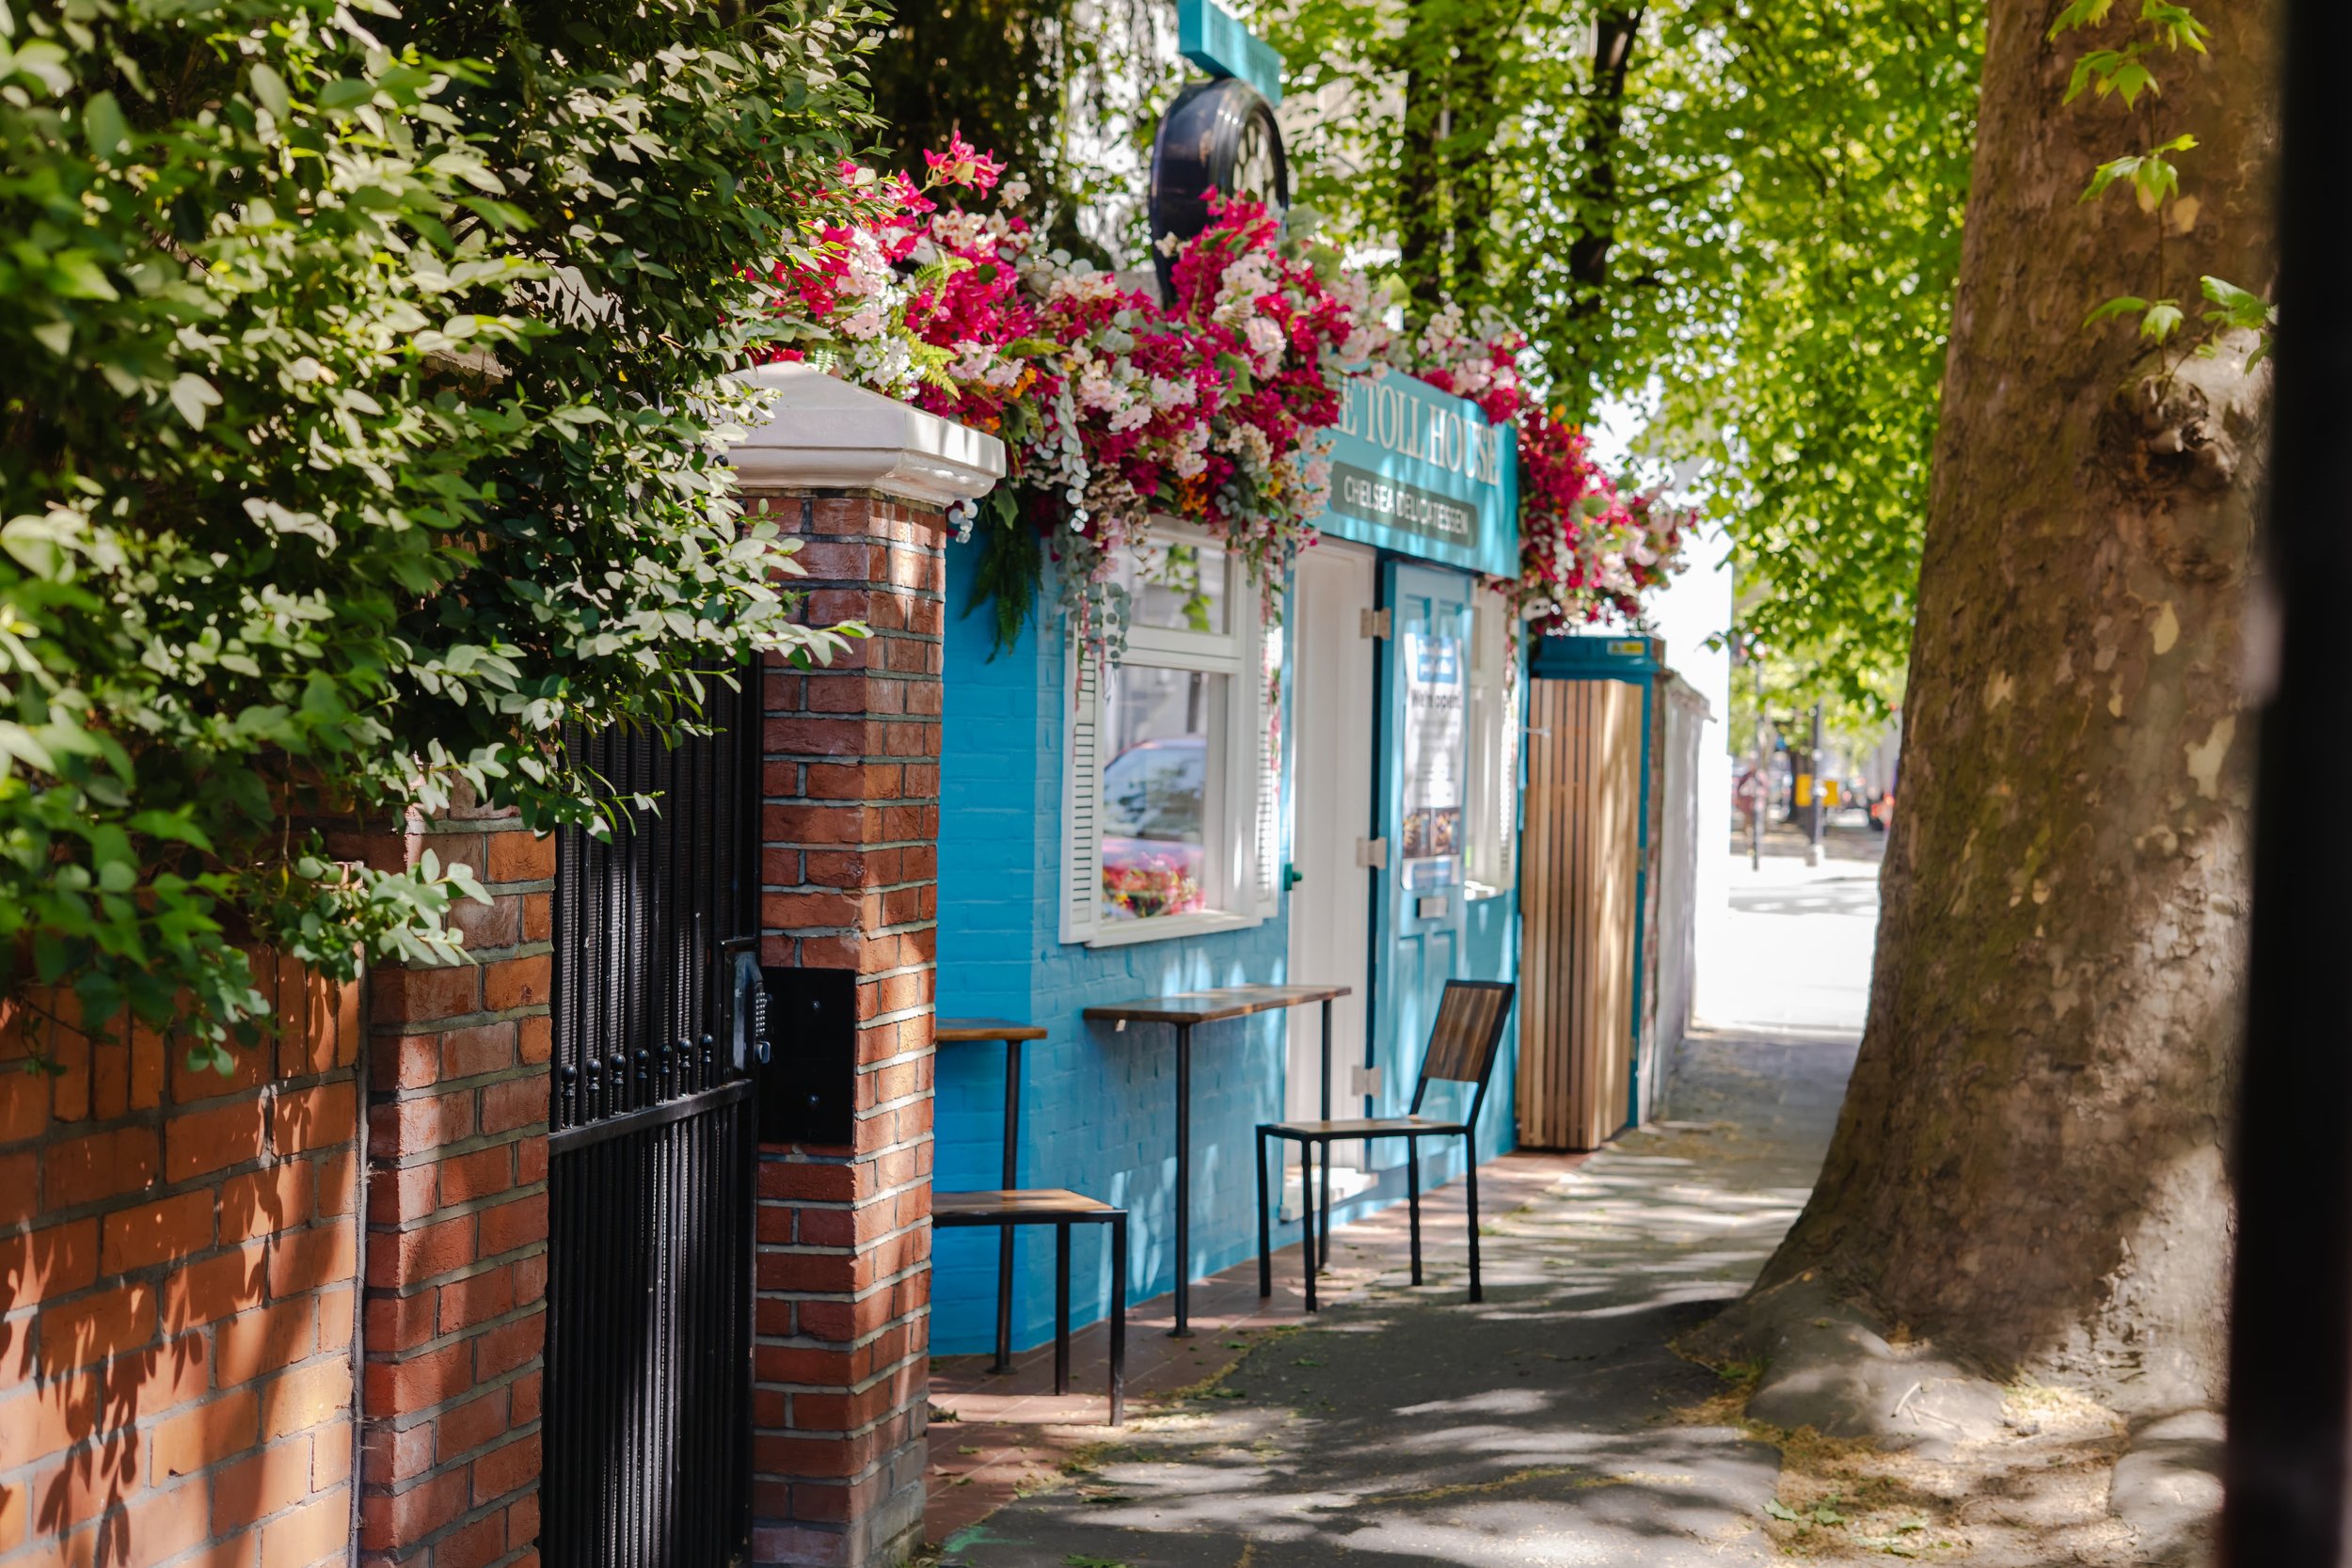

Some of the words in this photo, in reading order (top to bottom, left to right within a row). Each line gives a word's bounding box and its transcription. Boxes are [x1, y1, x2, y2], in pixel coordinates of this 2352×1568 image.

[1362, 378, 1425, 459] TOLL
[1429, 404, 1499, 486] HOUSE
[1343, 475, 1395, 515] CHELSEA
[1396, 490, 1469, 535] DELICATESSEN
